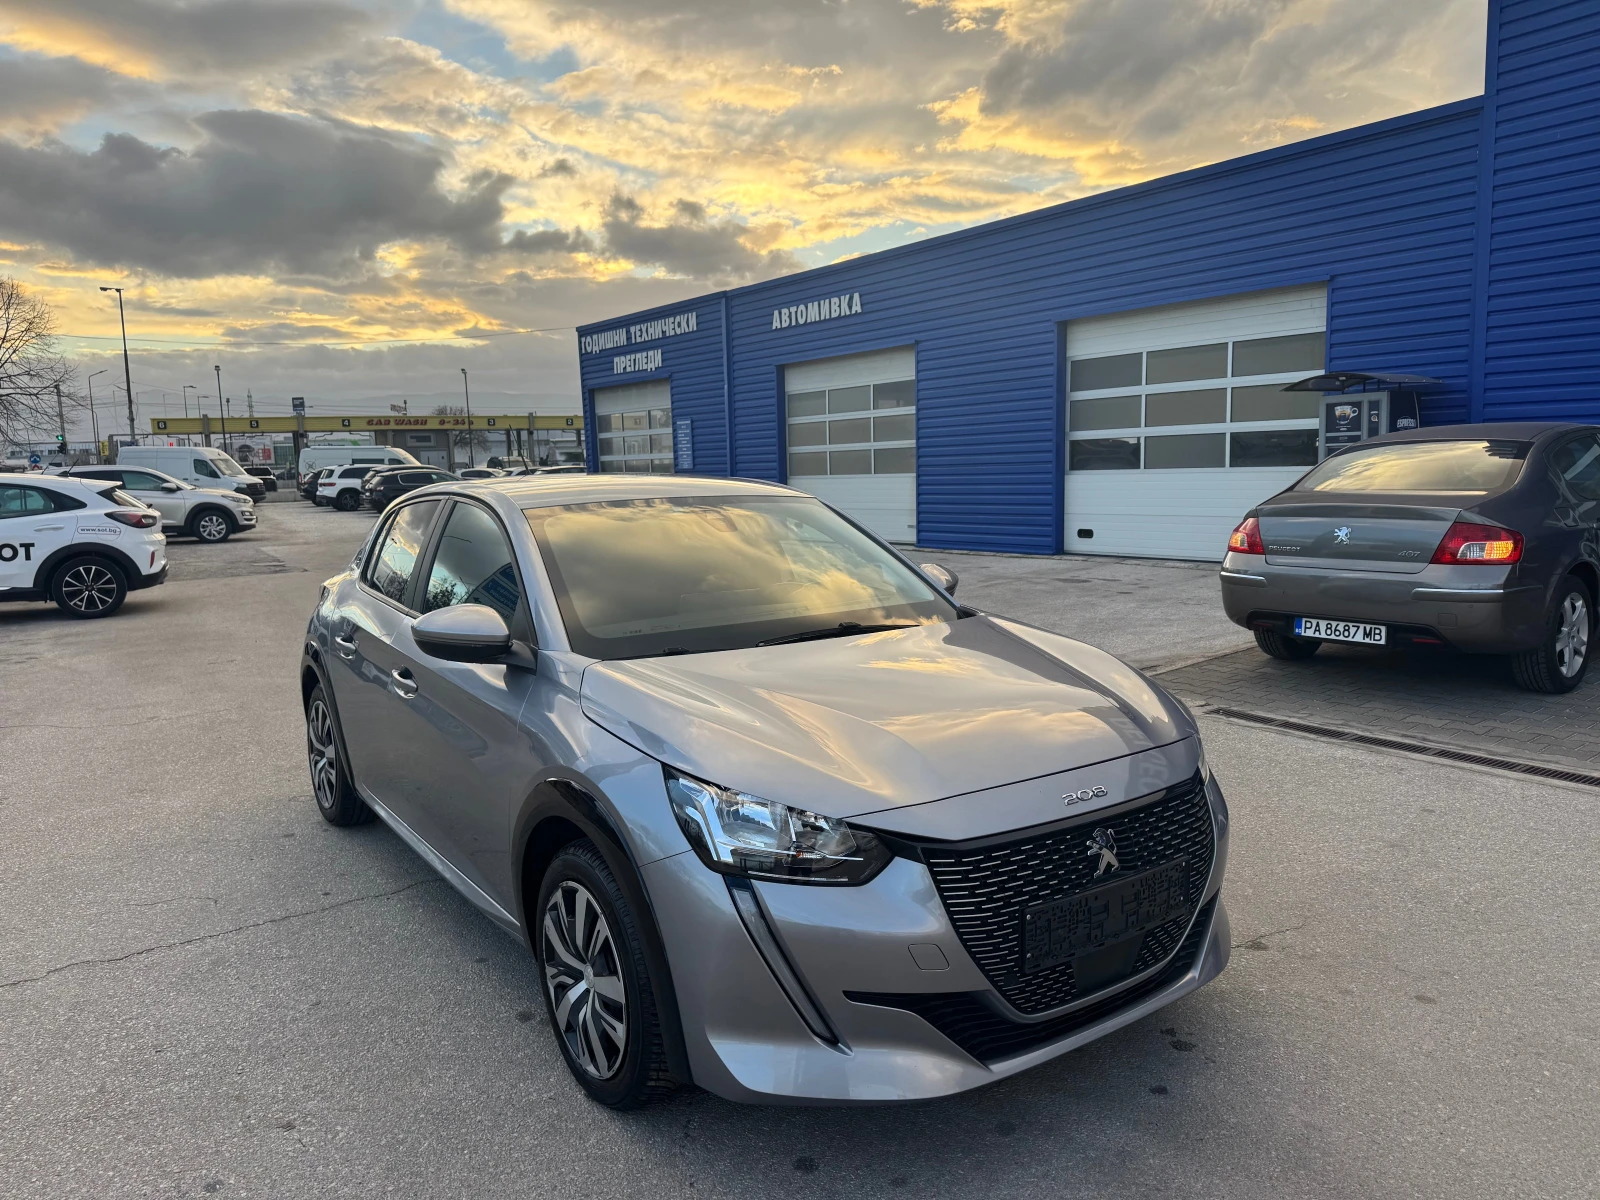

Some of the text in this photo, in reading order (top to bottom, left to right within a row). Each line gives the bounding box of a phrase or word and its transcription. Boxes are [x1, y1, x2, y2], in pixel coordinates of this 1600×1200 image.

[772, 292, 862, 329] АВТОМИВКА
[581, 312, 697, 354] ГОДИШНИ ТЕХНИЧЕСКИ
[613, 349, 662, 374] ПРЕГЛЕДИ
[366, 418, 391, 426] CAR
[395, 418, 428, 426] WASH
[1398, 550, 1421, 558] 407
[1303, 620, 1383, 642] PA 8687 MB
[1061, 785, 1108, 806] 208
